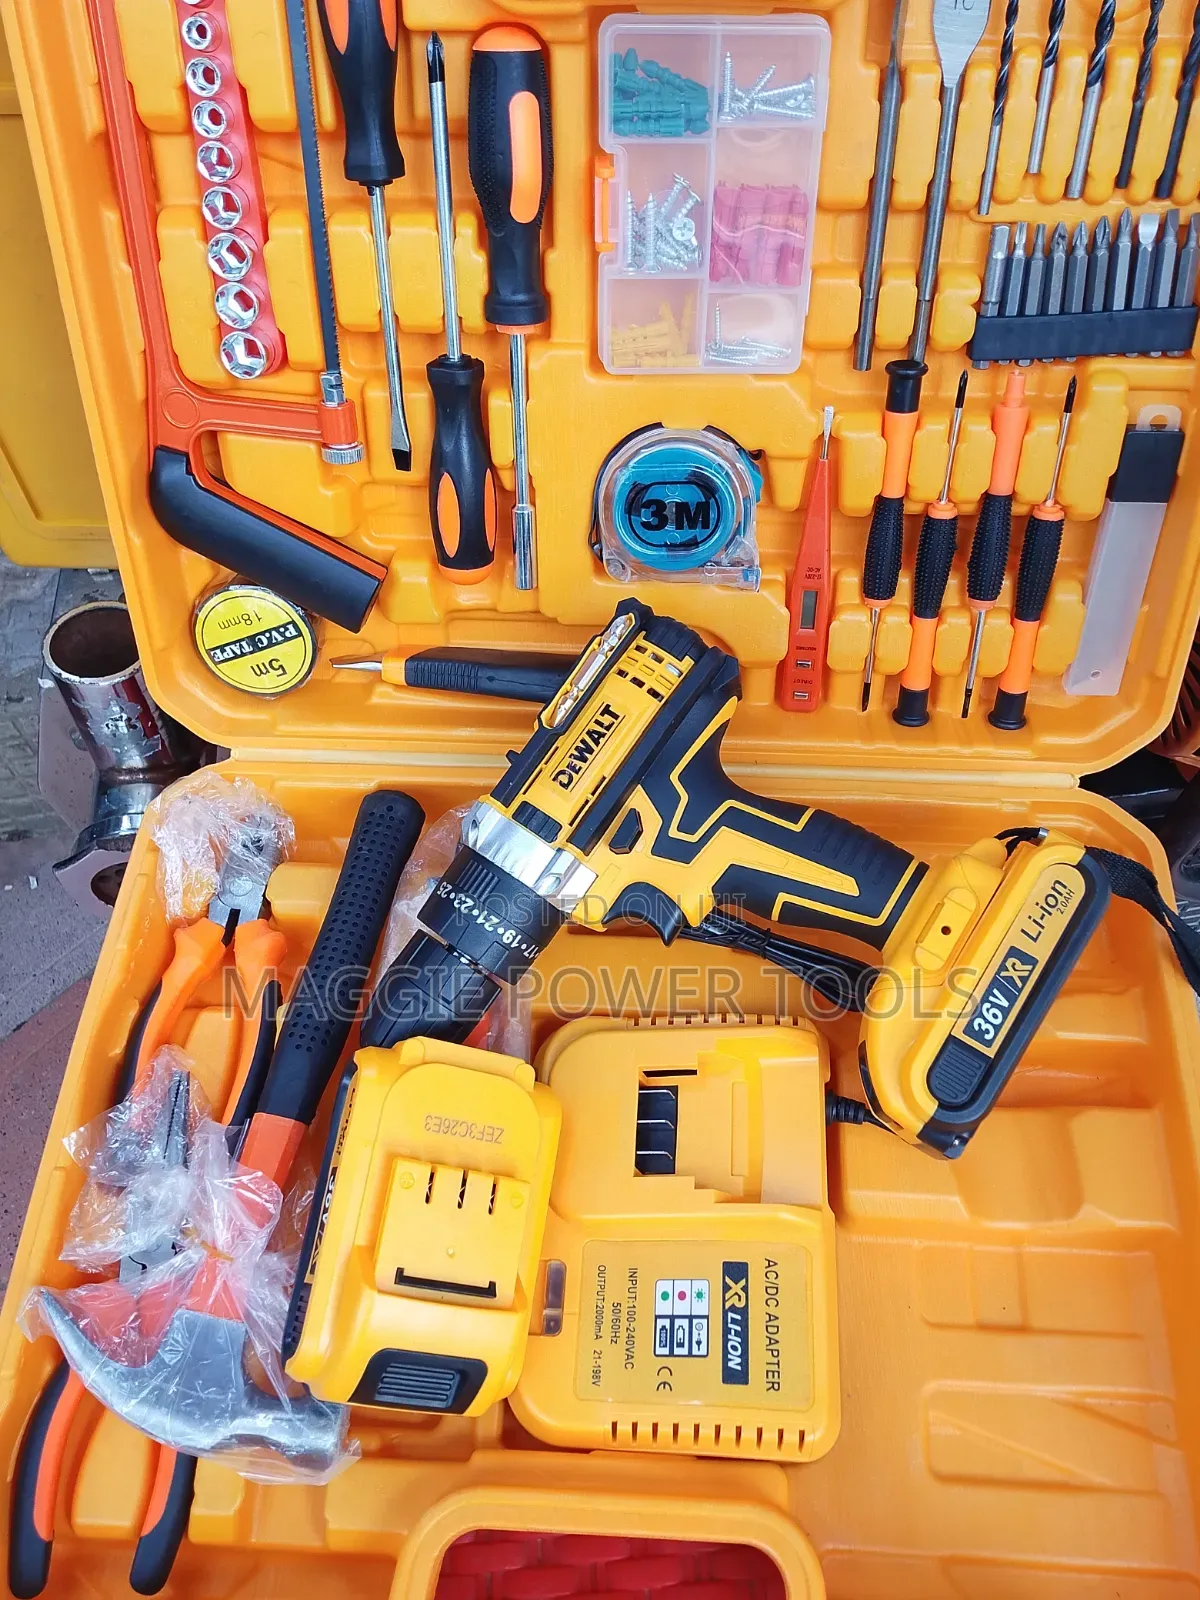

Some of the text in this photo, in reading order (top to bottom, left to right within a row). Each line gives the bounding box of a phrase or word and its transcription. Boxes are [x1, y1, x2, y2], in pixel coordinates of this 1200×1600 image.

[640, 499, 711, 531] 3M
[218, 610, 262, 630] 18mm
[210, 640, 254, 662] TAPE
[250, 658, 288, 678] 5m
[453, 893, 475, 913] 23
[1020, 879, 1068, 943] Li-ion
[1056, 889, 1075, 915] 2.0AH
[476, 910, 500, 932] 21
[502, 929, 522, 948] 19
[594, 1264, 607, 1341] OUTPUT:2000mA
[725, 1275, 746, 1310] XR
[610, 1302, 622, 1345] 50/60Hz
[624, 1267, 638, 1370] INPUT:100-240VAC
[764, 1258, 781, 1392] AC/DC ADAPTER
